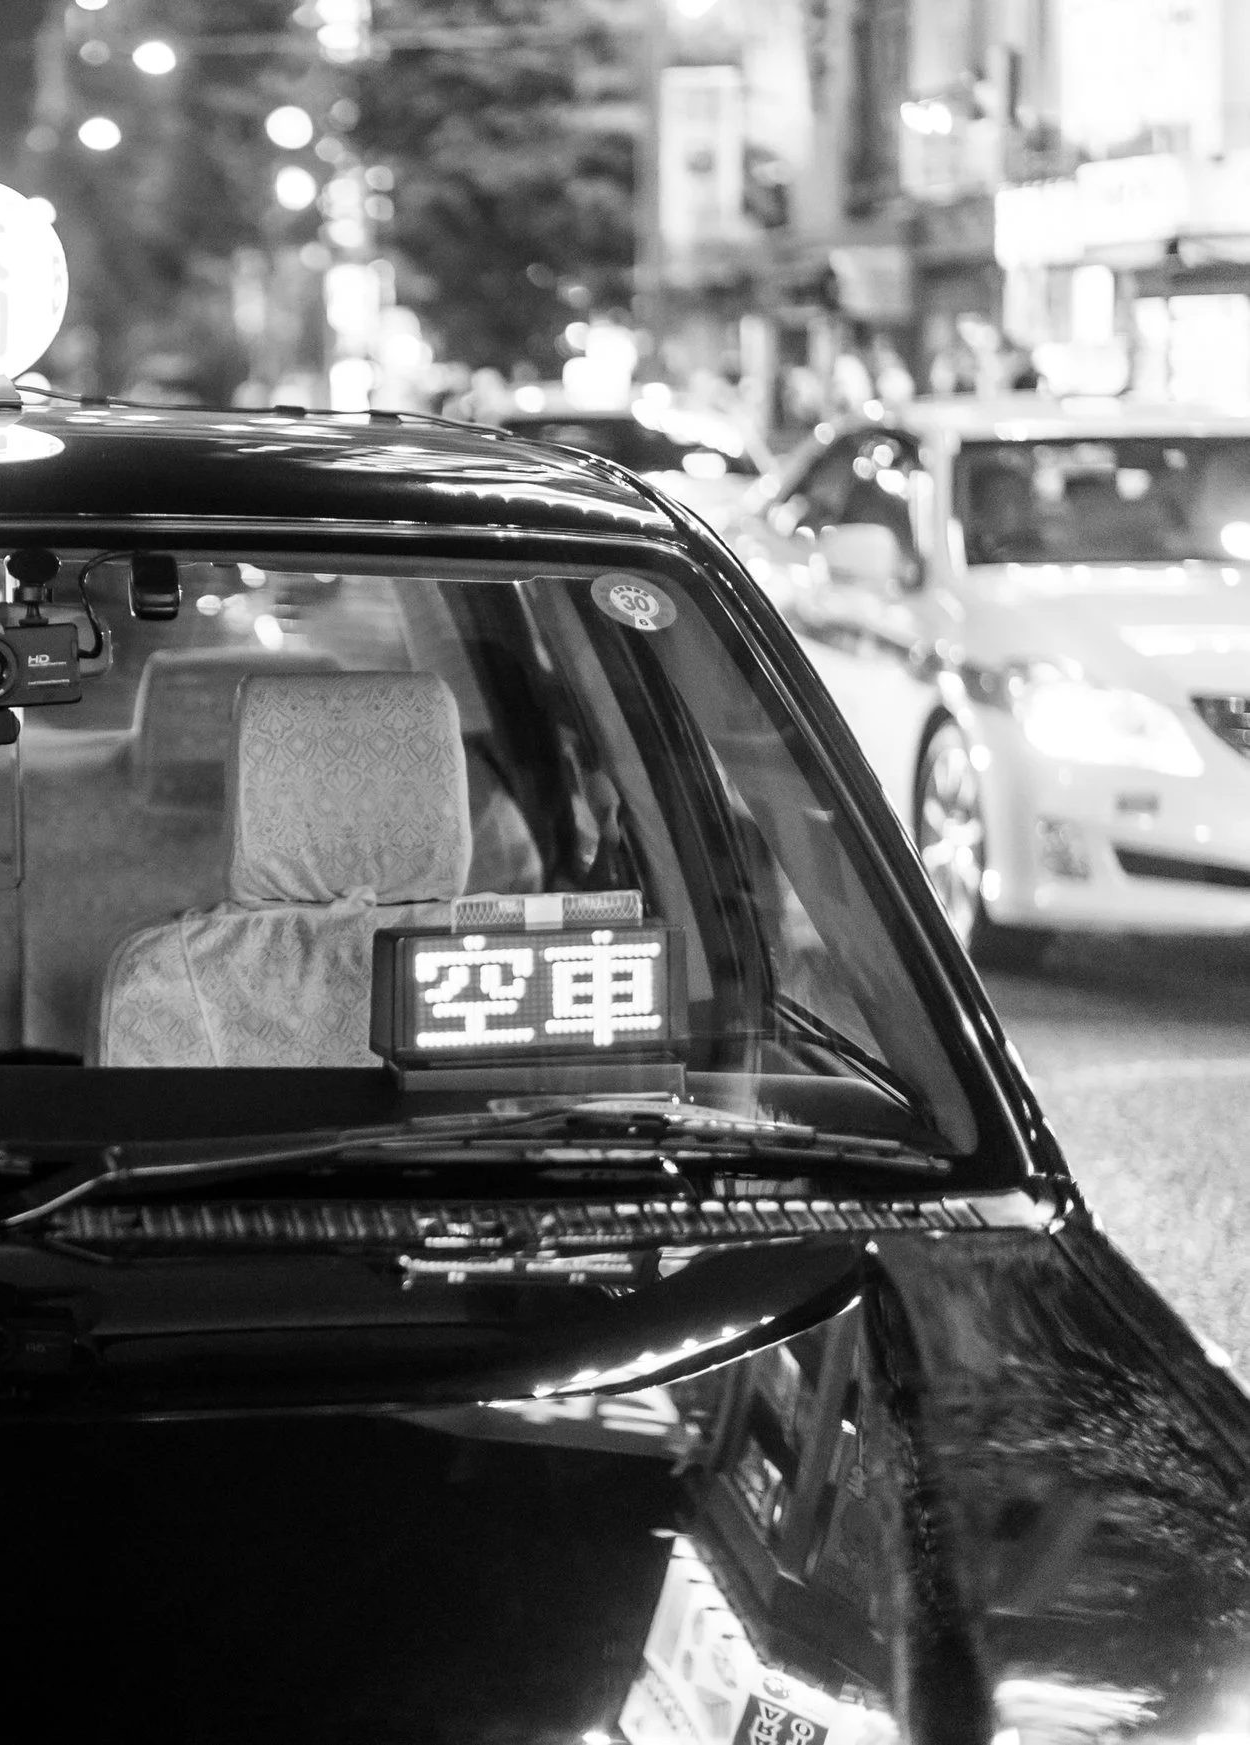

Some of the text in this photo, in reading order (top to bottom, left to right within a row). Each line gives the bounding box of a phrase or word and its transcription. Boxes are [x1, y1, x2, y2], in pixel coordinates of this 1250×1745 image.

[620, 594, 650, 612] 30
[28, 654, 50, 664] HD
[414, 929, 662, 1048] 空車
